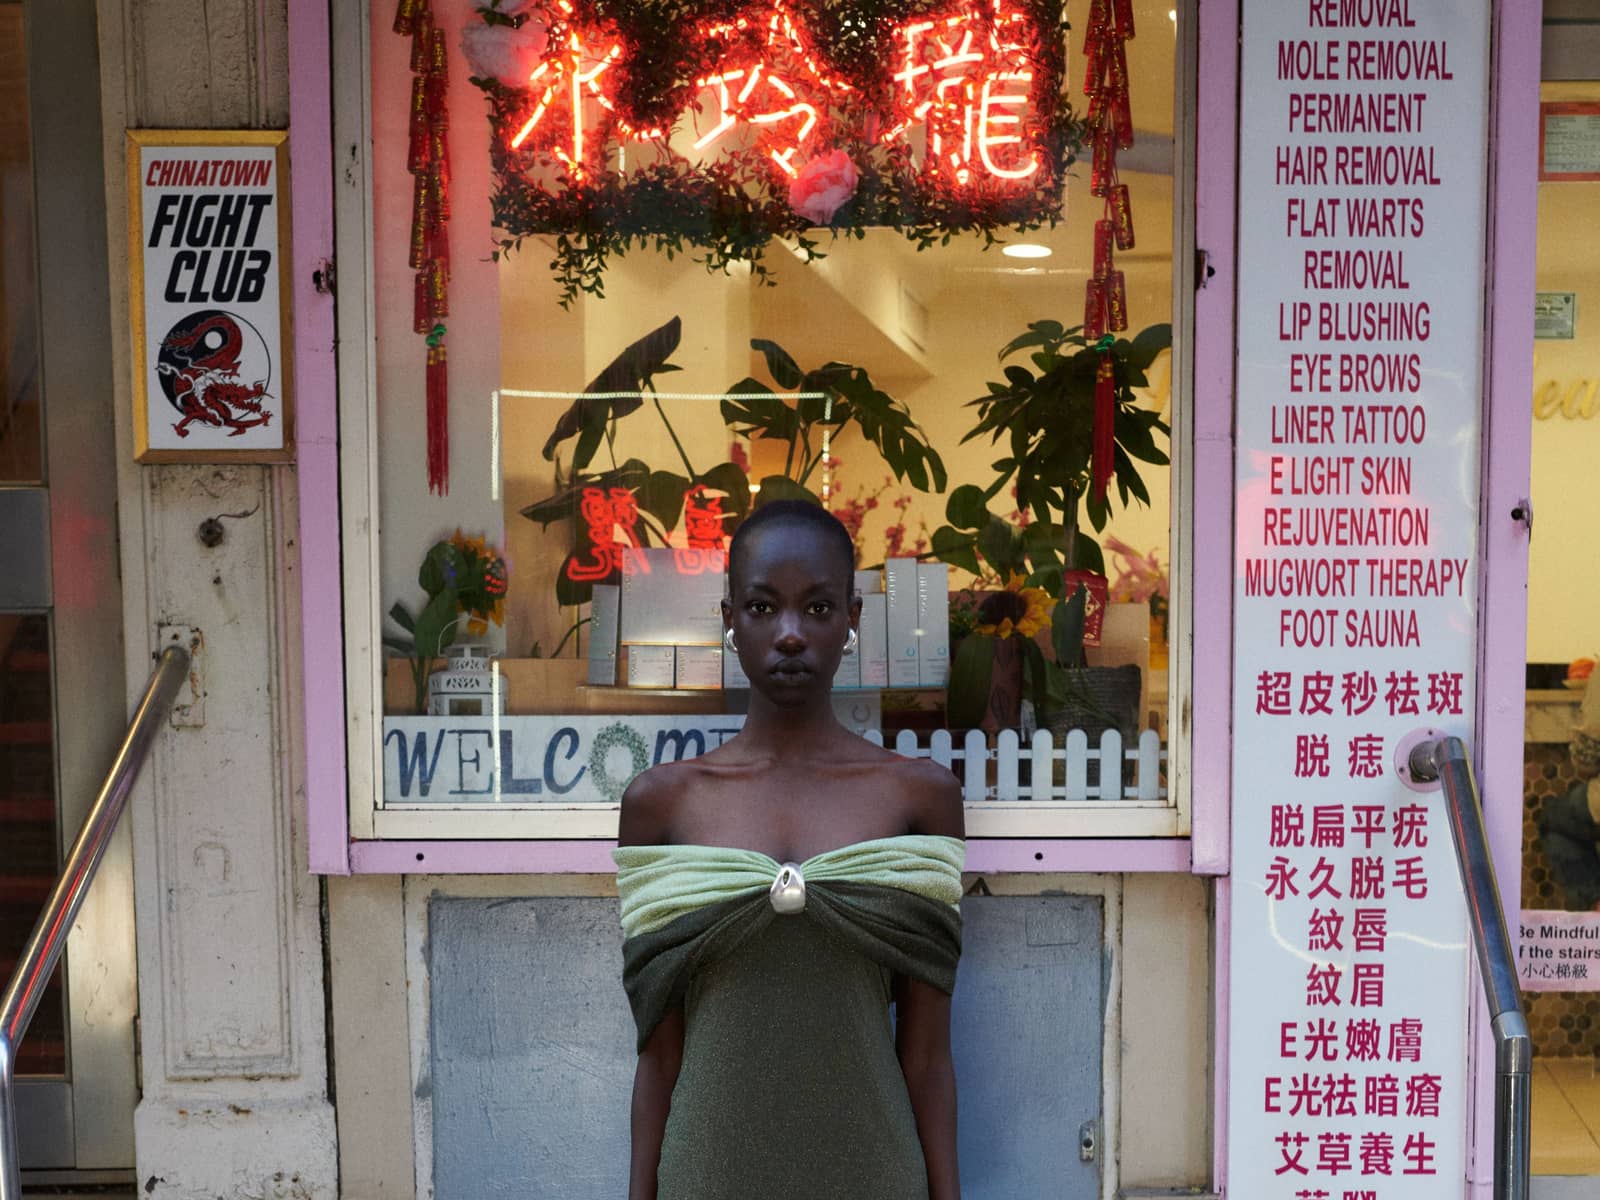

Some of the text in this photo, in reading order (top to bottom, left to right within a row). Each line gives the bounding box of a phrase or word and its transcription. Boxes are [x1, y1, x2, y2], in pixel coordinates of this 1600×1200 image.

[1309, 0, 1416, 27] REMOVAL
[1278, 40, 1453, 81] MOLE REMOVAL
[1289, 93, 1426, 133] PERMANENT
[145, 160, 272, 186] CHINATOWN
[1276, 146, 1441, 186] HAIR REMOVAL
[148, 194, 273, 248] FIGHT
[1287, 198, 1424, 238] FLAT WARTS
[164, 249, 272, 303] CLUB
[1304, 250, 1410, 290] REMOVAL
[1279, 301, 1431, 342] LIP BLUSHING
[1290, 353, 1421, 393] EYE BROWS
[1271, 405, 1426, 445] LINER TATTOO
[1270, 456, 1411, 496] E LIGHT SKIN
[1264, 507, 1429, 547] REJUVENATION
[1245, 558, 1468, 598] MUGWORT THERAPY
[1280, 609, 1420, 648] FOOT SAUNA
[1308, 908, 1388, 953] 紋唇
[1540, 925, 1599, 939] Mindful
[1529, 945, 1553, 959] the
[1559, 946, 1600, 959] stairs
[1306, 963, 1385, 1007] 紋眉
[1274, 1131, 1437, 1176] 艾草養生
